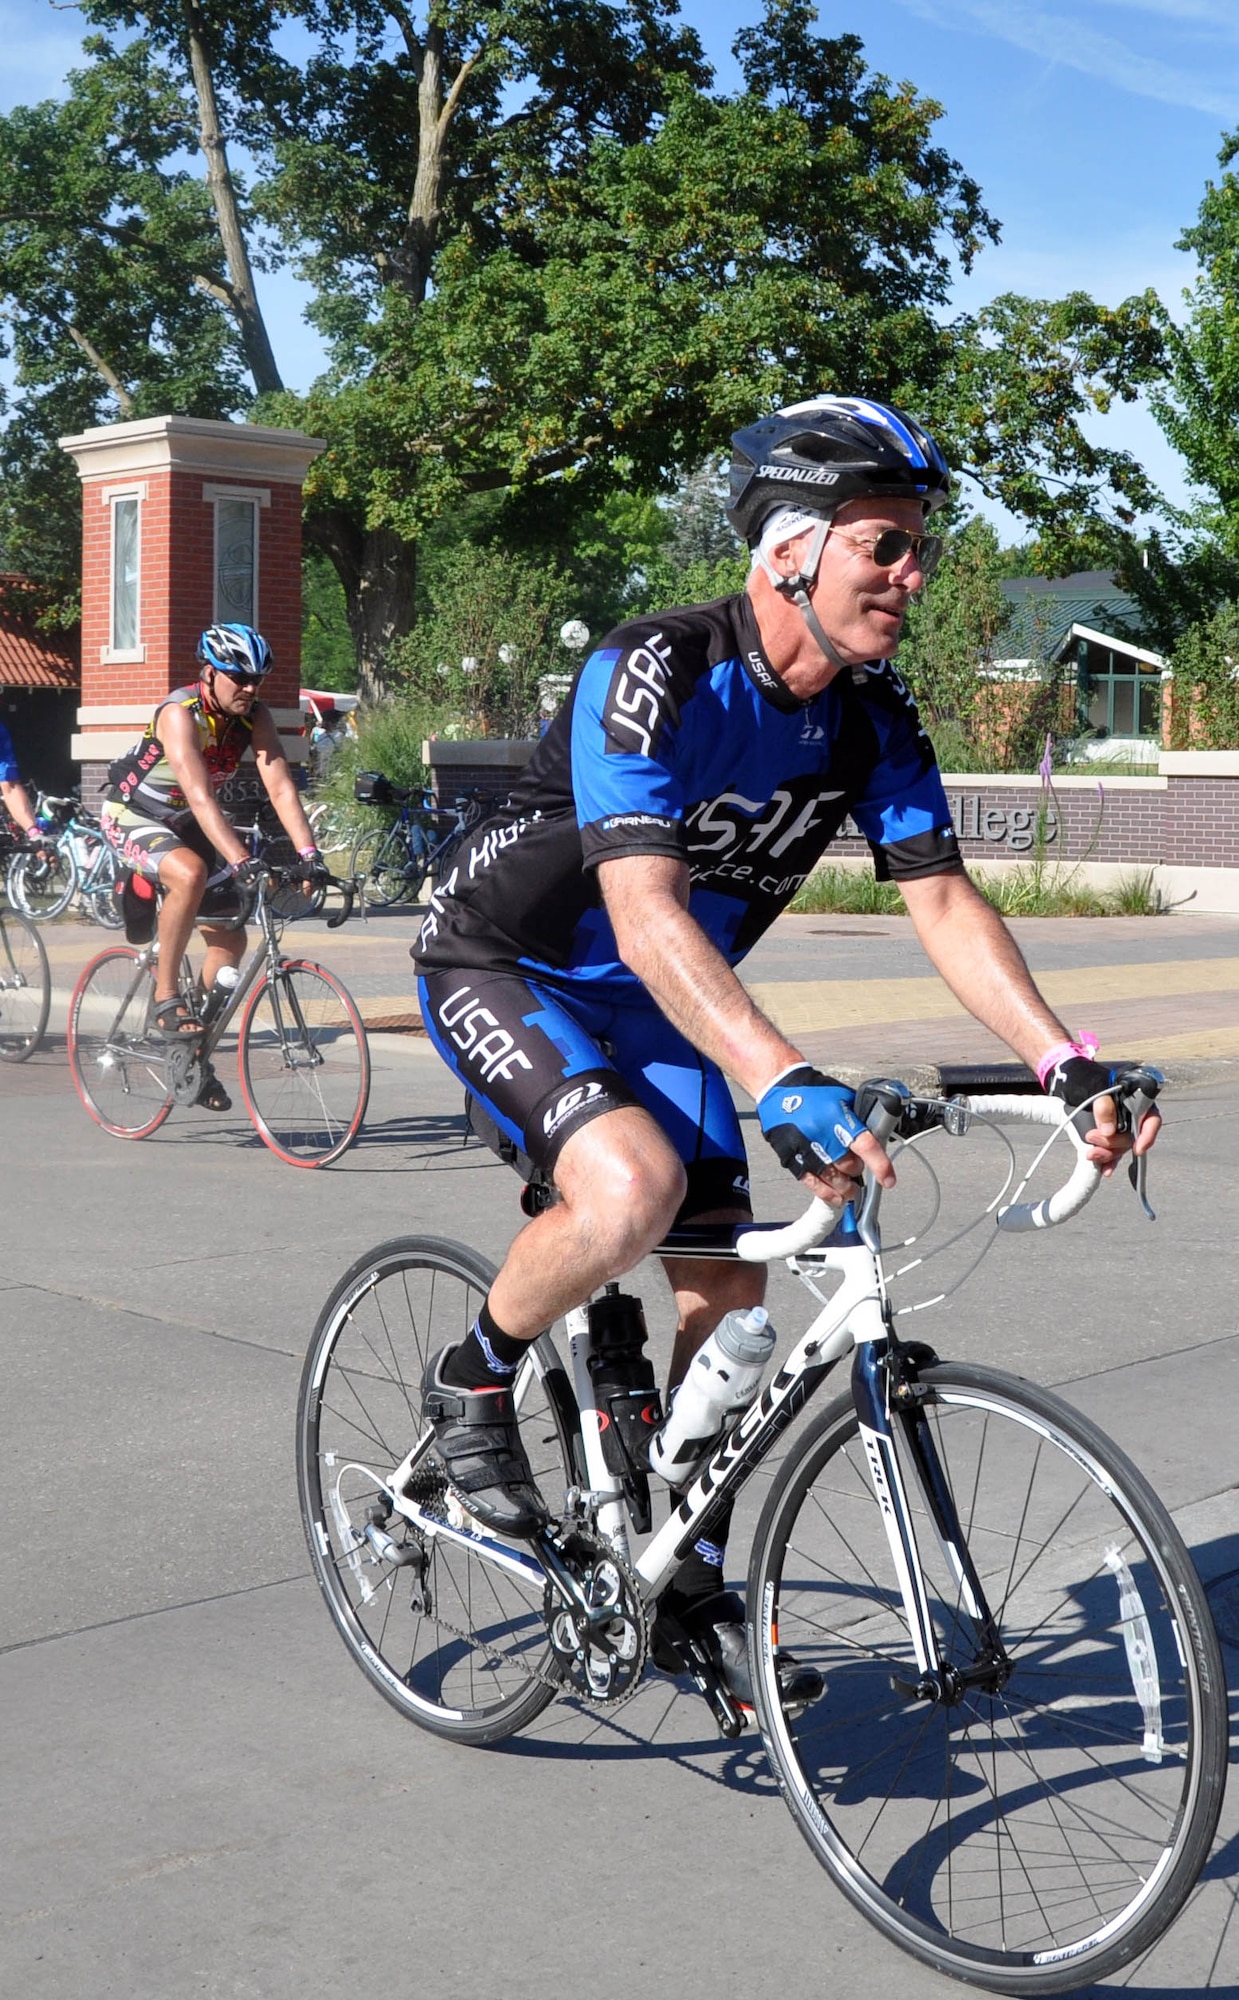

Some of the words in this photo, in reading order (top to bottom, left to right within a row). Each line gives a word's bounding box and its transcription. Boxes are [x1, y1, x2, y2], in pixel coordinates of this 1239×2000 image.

[755, 464, 841, 486] SPECIALIZED
[747, 651, 778, 690] USAF
[216, 780, 261, 803] 853
[609, 815, 672, 830] GARNEAU
[686, 790, 847, 859] SAF
[949, 795, 1058, 851] llege
[438, 986, 534, 1084] USAF
[865, 1440, 892, 1516] TREK
